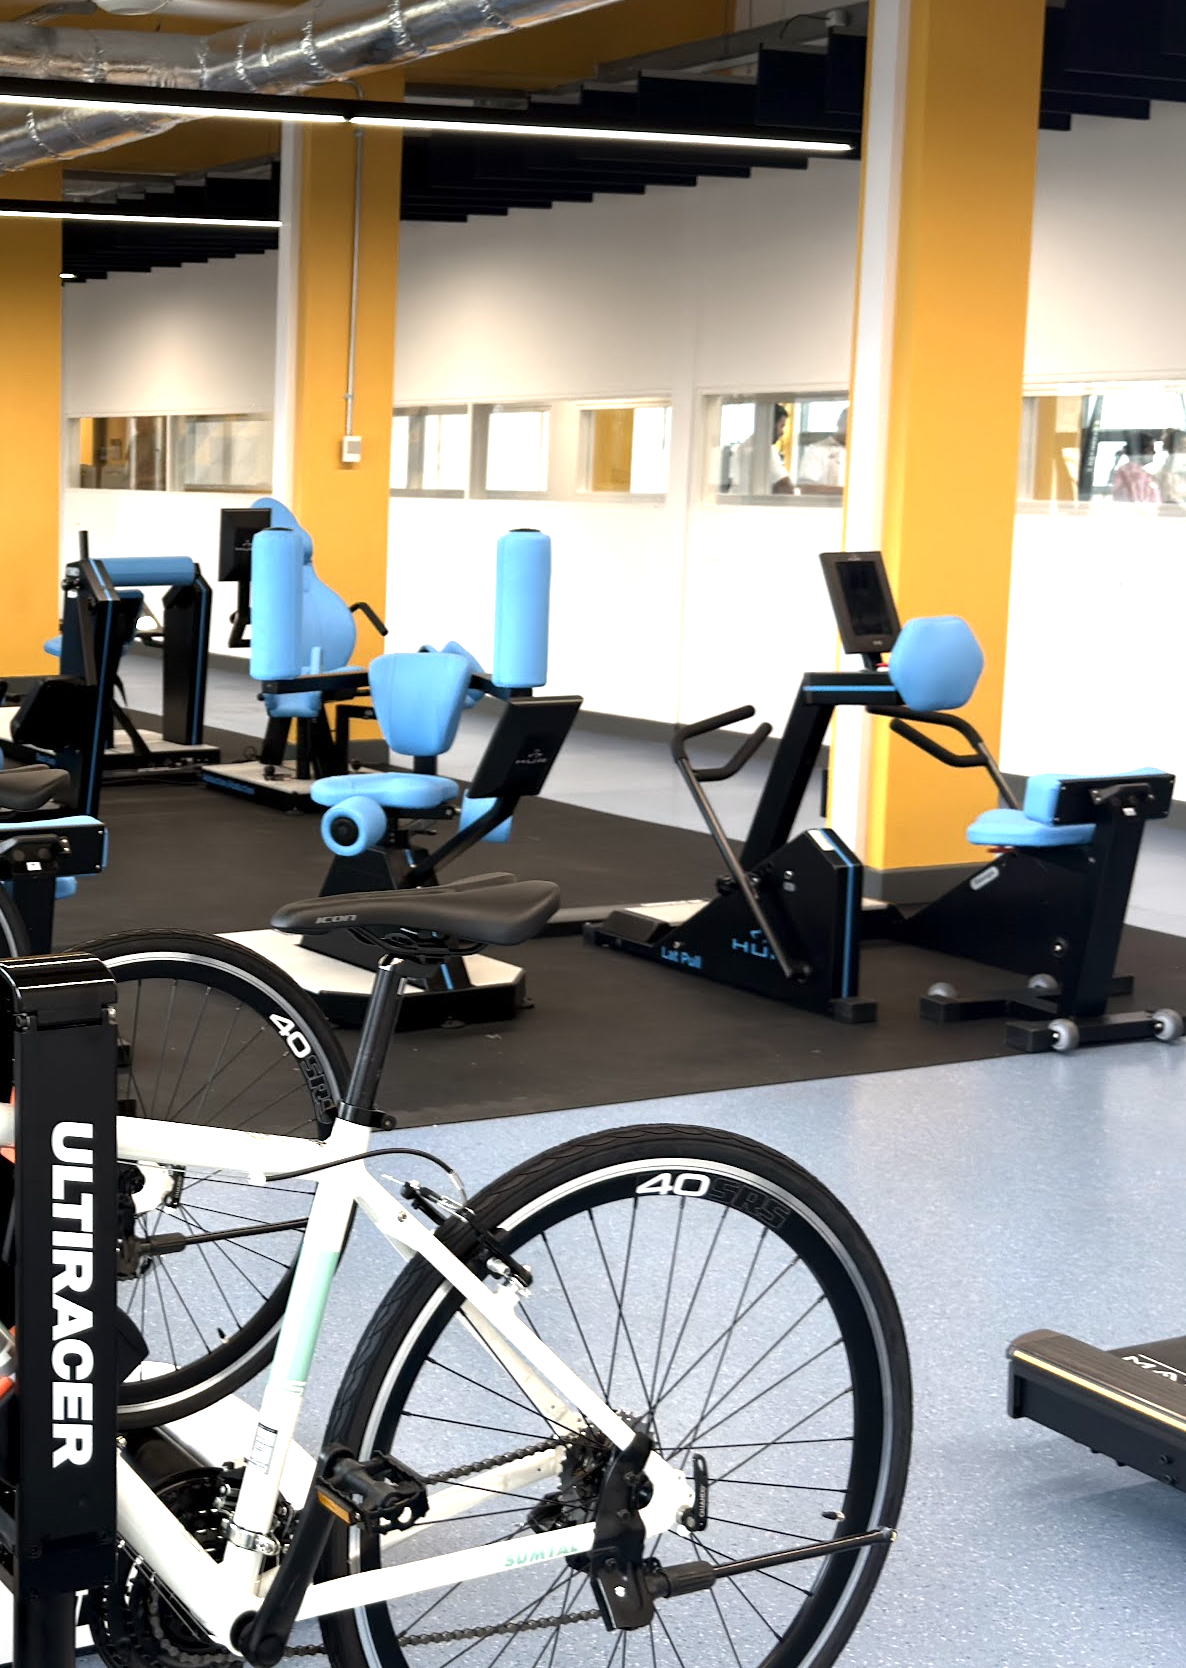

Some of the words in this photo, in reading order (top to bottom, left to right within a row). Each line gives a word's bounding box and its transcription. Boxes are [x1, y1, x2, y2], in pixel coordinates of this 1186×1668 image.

[731, 937, 776, 961] HU
[268, 1013, 312, 1059] 40
[635, 1171, 711, 1198] 40
[50, 1121, 95, 1469] ULTIRACER
[1121, 1355, 1186, 1388] MA
